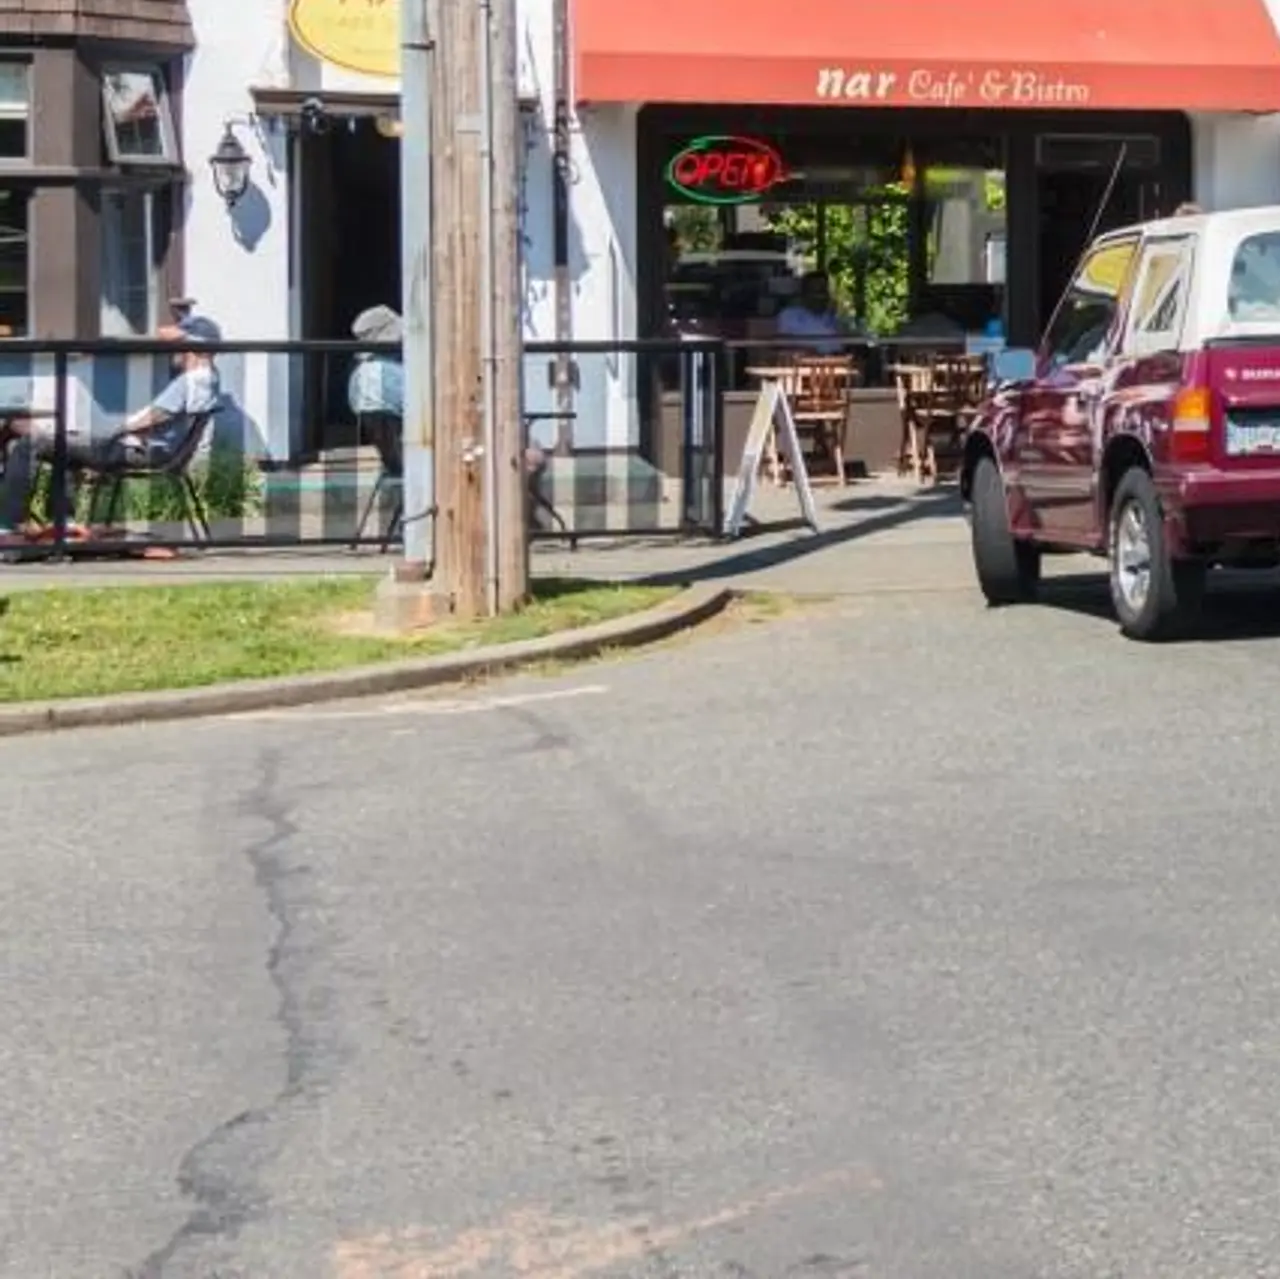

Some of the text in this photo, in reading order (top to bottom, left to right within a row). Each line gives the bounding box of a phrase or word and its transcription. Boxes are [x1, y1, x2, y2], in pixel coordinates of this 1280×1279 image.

[816, 67, 896, 99] nar
[979, 68, 1007, 102] &
[1009, 70, 1090, 104] Bistro
[674, 152, 771, 191] OPEN
